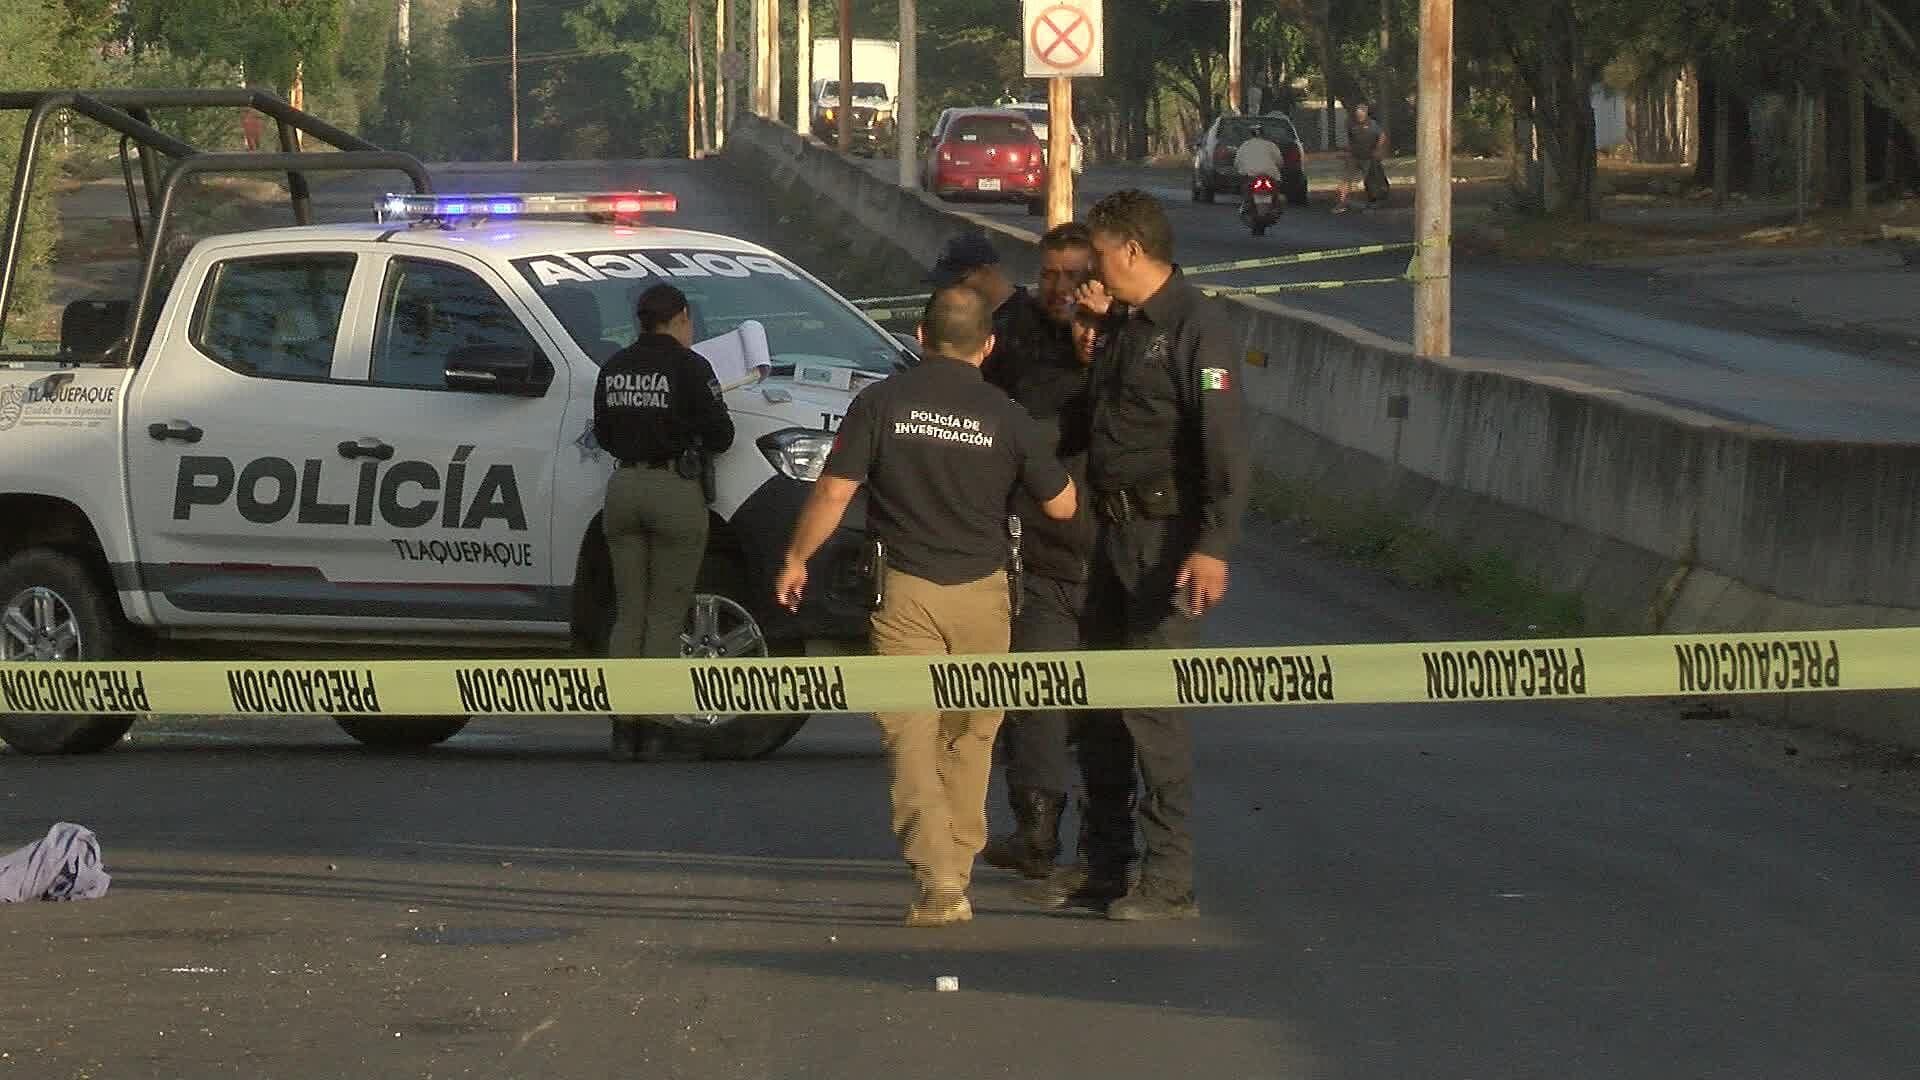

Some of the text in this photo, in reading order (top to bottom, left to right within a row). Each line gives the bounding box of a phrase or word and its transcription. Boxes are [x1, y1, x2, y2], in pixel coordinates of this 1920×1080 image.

[29, 386, 113, 403] TLAQUEPAQUE
[606, 372, 670, 392] POLICÍA
[910, 410, 981, 431] POLICÍA DE
[895, 422, 993, 447] INVESTIGACIÓN
[172, 444, 528, 531] POLICÍA
[391, 538, 532, 567] TLAQUEPAQUE
[0, 639, 1840, 713] PRECAUCION PRECAUCION PRECAUCION PRECAUCION PRECAUCION PRECAUCION PRECAUCION PRECAUCION
